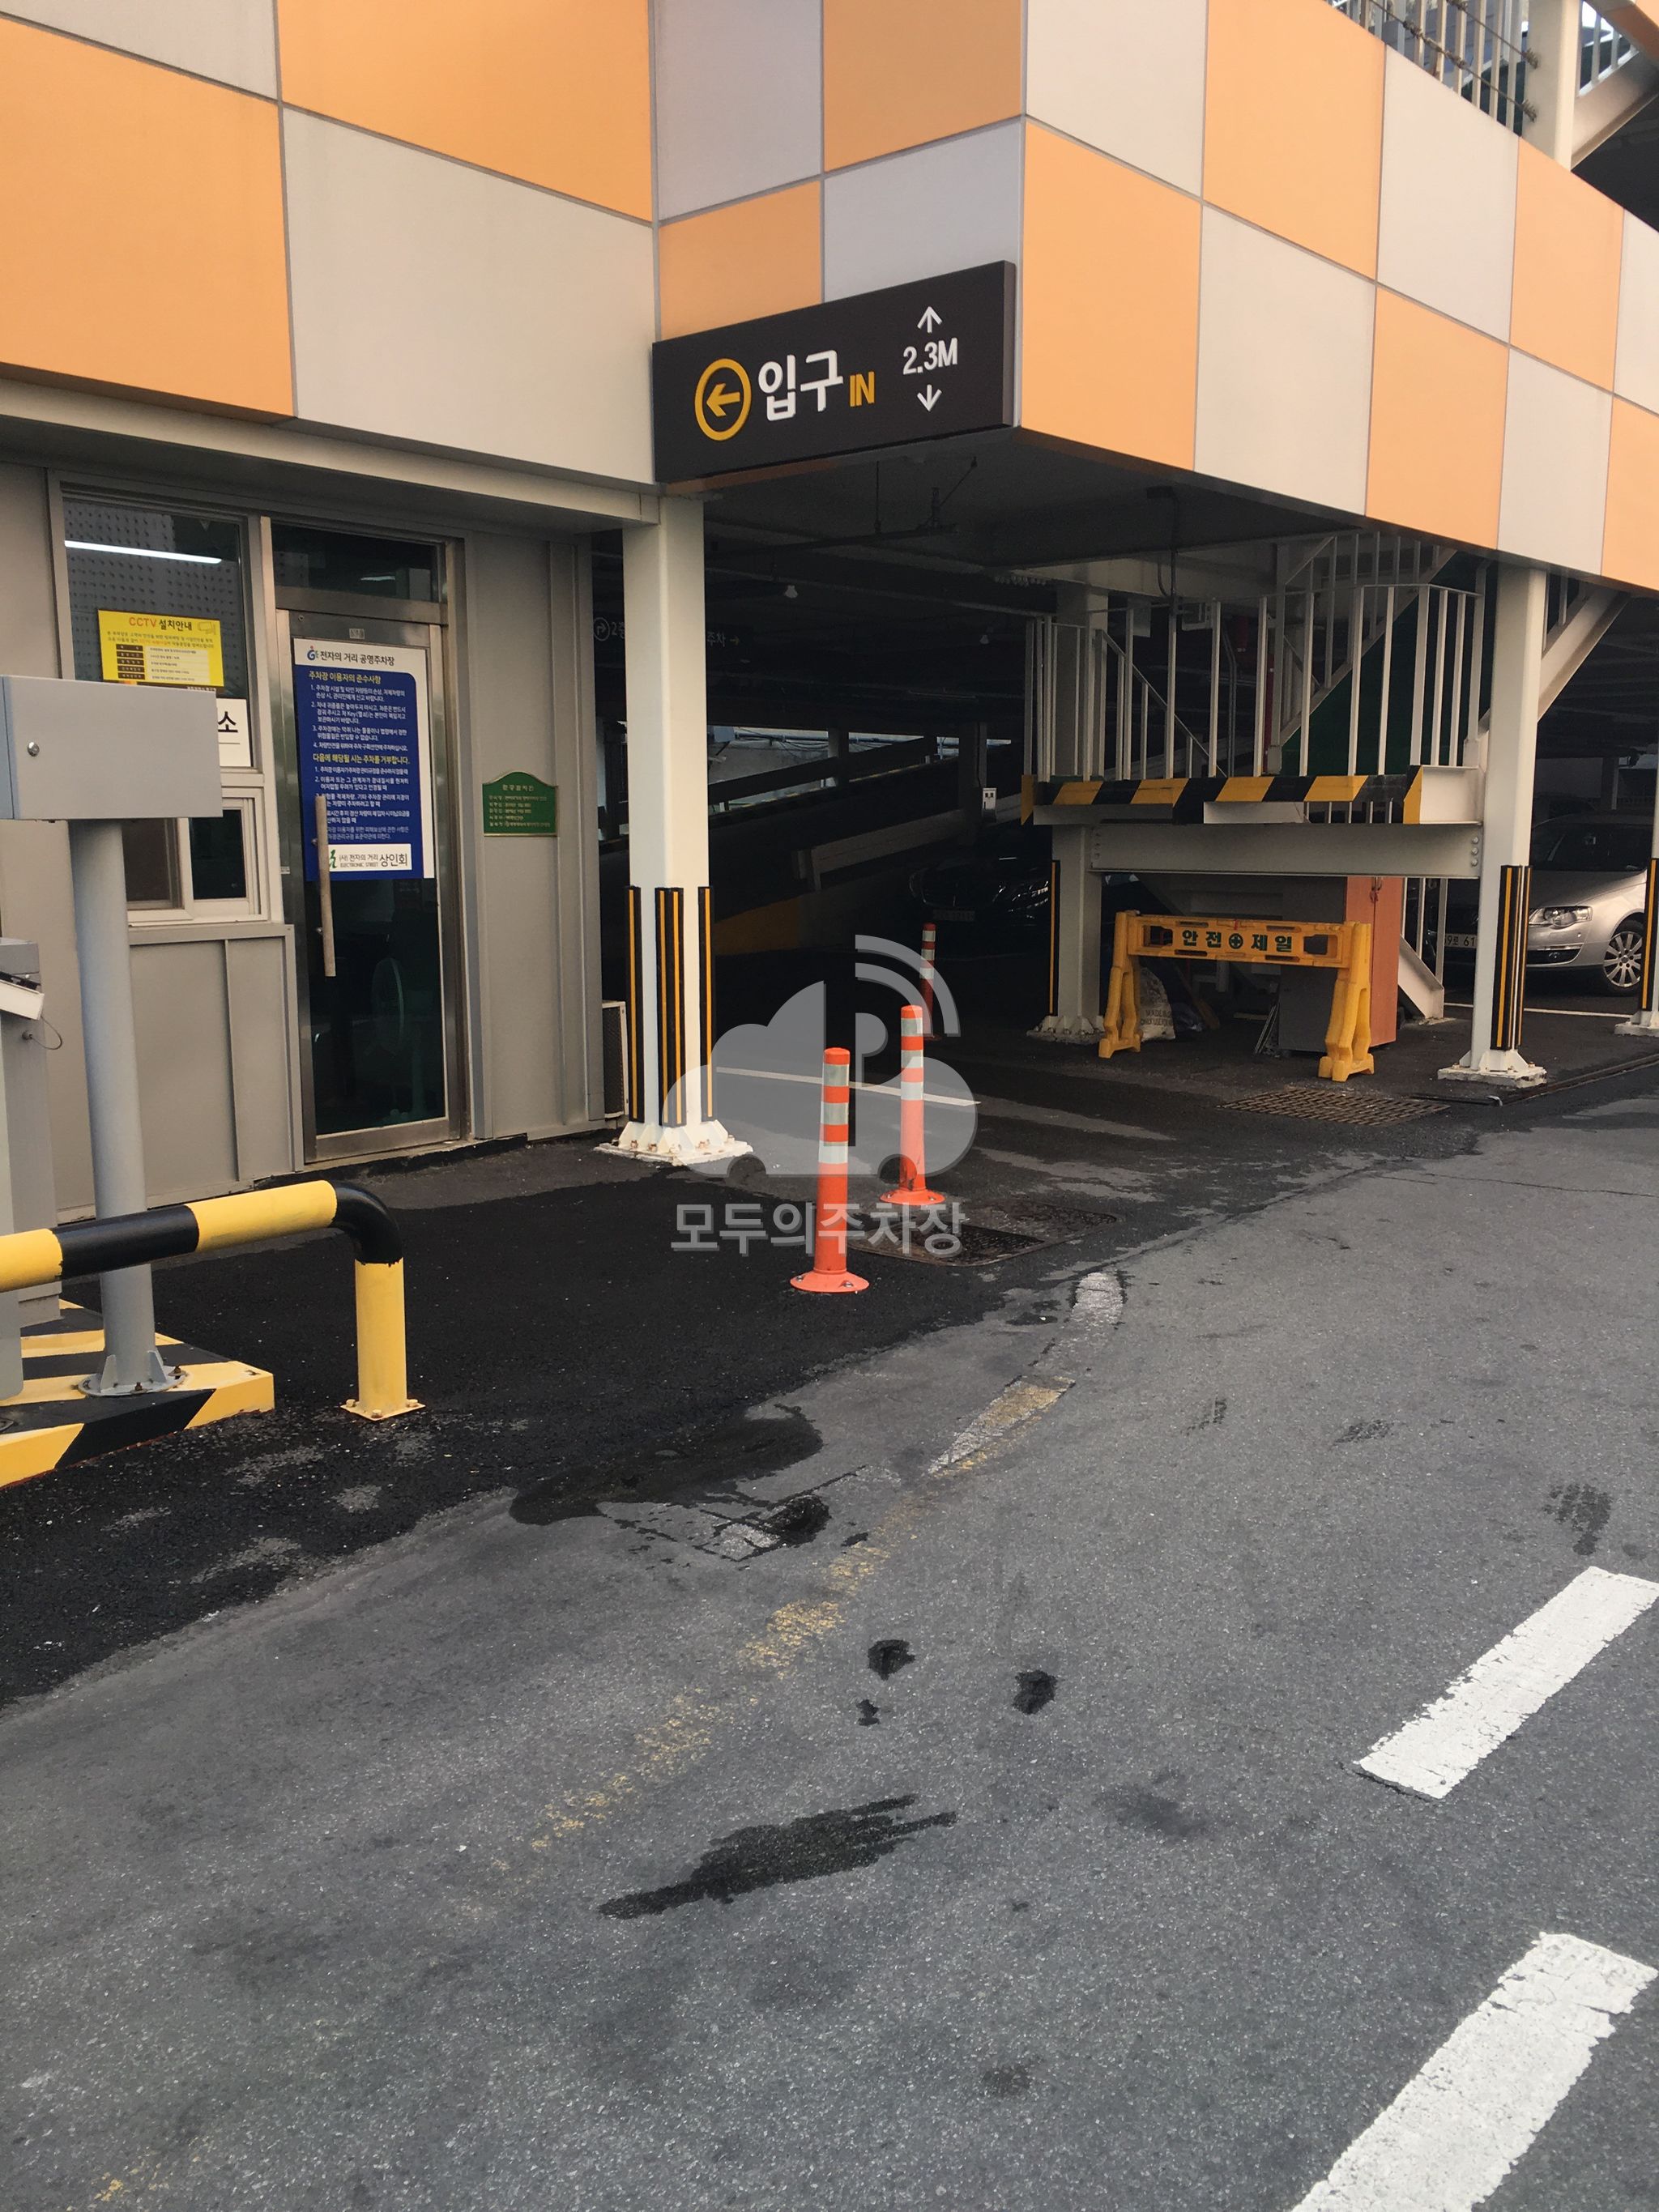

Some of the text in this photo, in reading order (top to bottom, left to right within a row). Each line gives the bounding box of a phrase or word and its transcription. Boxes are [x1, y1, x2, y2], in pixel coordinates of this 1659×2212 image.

[902, 337, 959, 375] 2.3M
[758, 349, 876, 422] 입구 IN
[129, 616, 193, 632] CCTV 설치안내
[320, 650, 342, 662] 전자의
[343, 653, 358, 663] 거리
[360, 654, 394, 667] 공영주차장
[309, 671, 382, 684] 주차장 이용자의 준수사항
[313, 753, 331, 762] 다음에
[349, 854, 366, 862] 전자의
[379, 853, 408, 867] 상인회
[1182, 930, 1293, 953] 안전 제일
